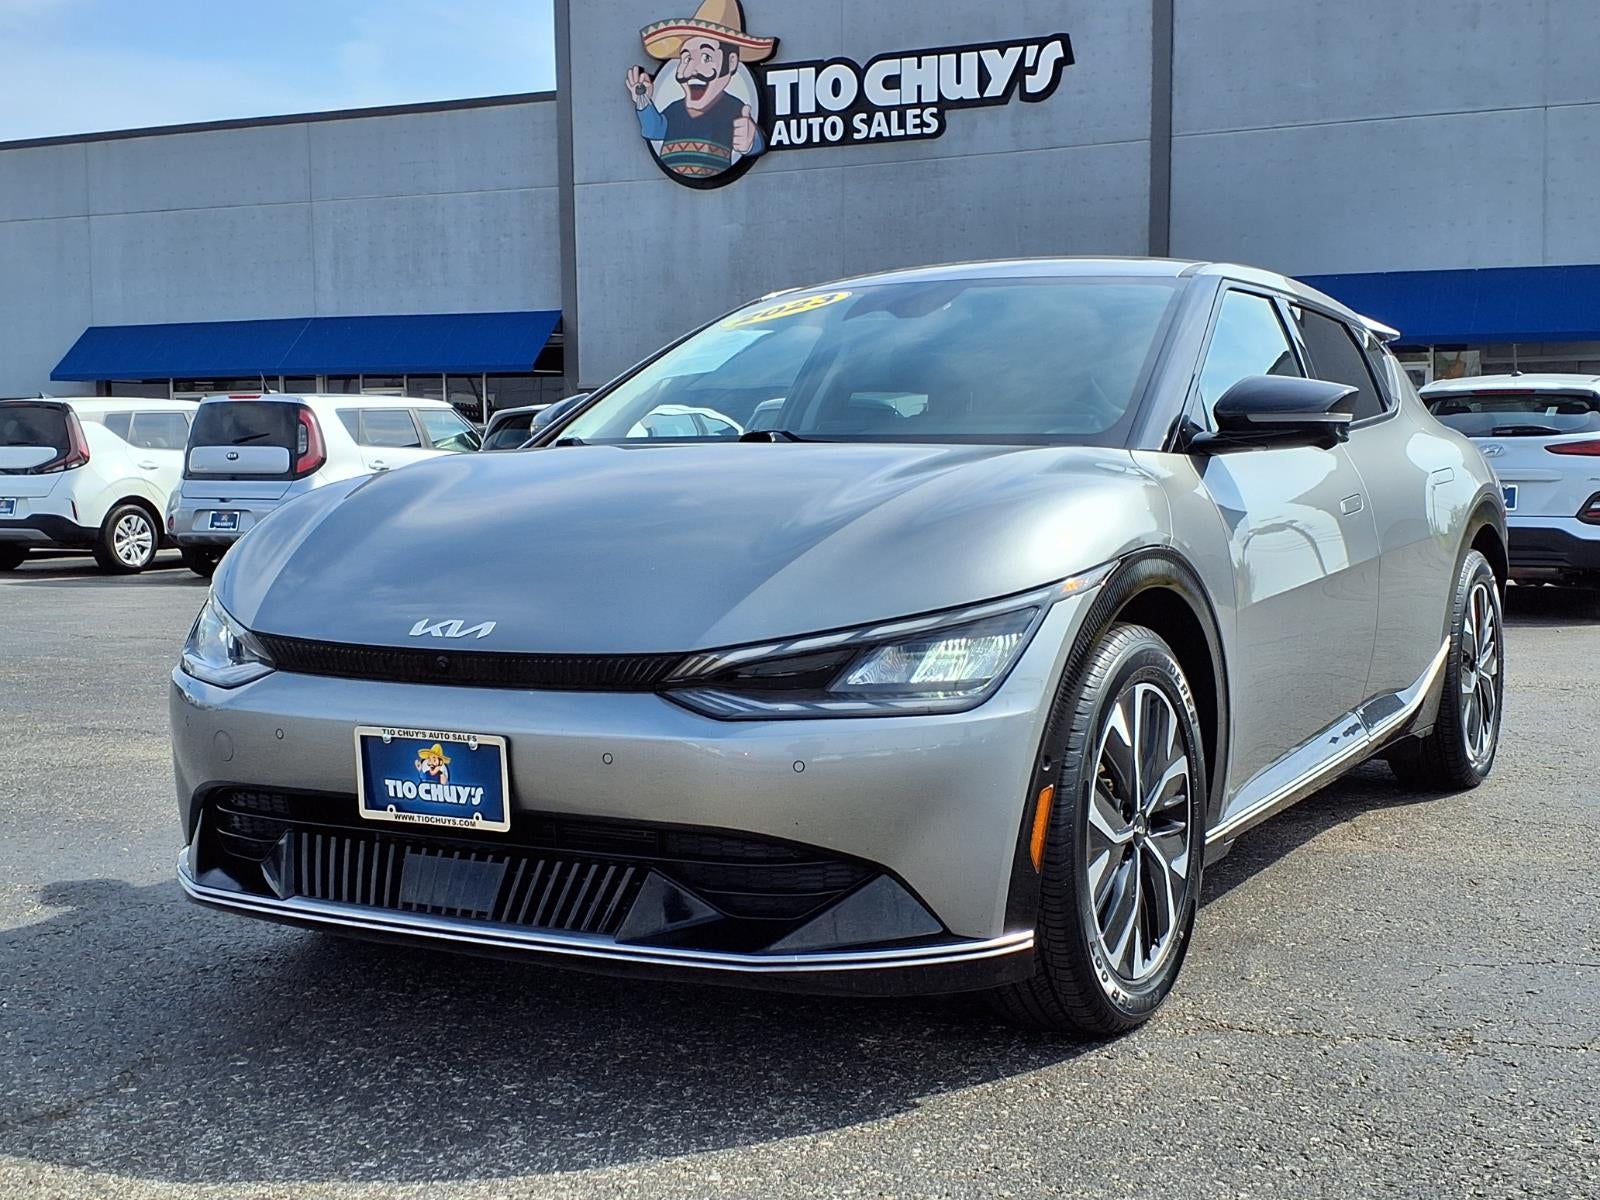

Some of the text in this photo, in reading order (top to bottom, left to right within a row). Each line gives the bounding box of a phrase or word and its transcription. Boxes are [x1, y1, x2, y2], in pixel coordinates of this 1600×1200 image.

[766, 40, 1064, 115] TIO CHUY'S
[770, 107, 939, 146] AUTO SALES
[409, 618, 496, 639] KIA
[397, 730, 427, 739] CHUY'S
[429, 732, 450, 740] AUTO
[452, 733, 478, 742] SALES
[384, 779, 484, 805] TIO CHUY'S
[393, 813, 477, 828] WWW.TIOCHUYS.COM
